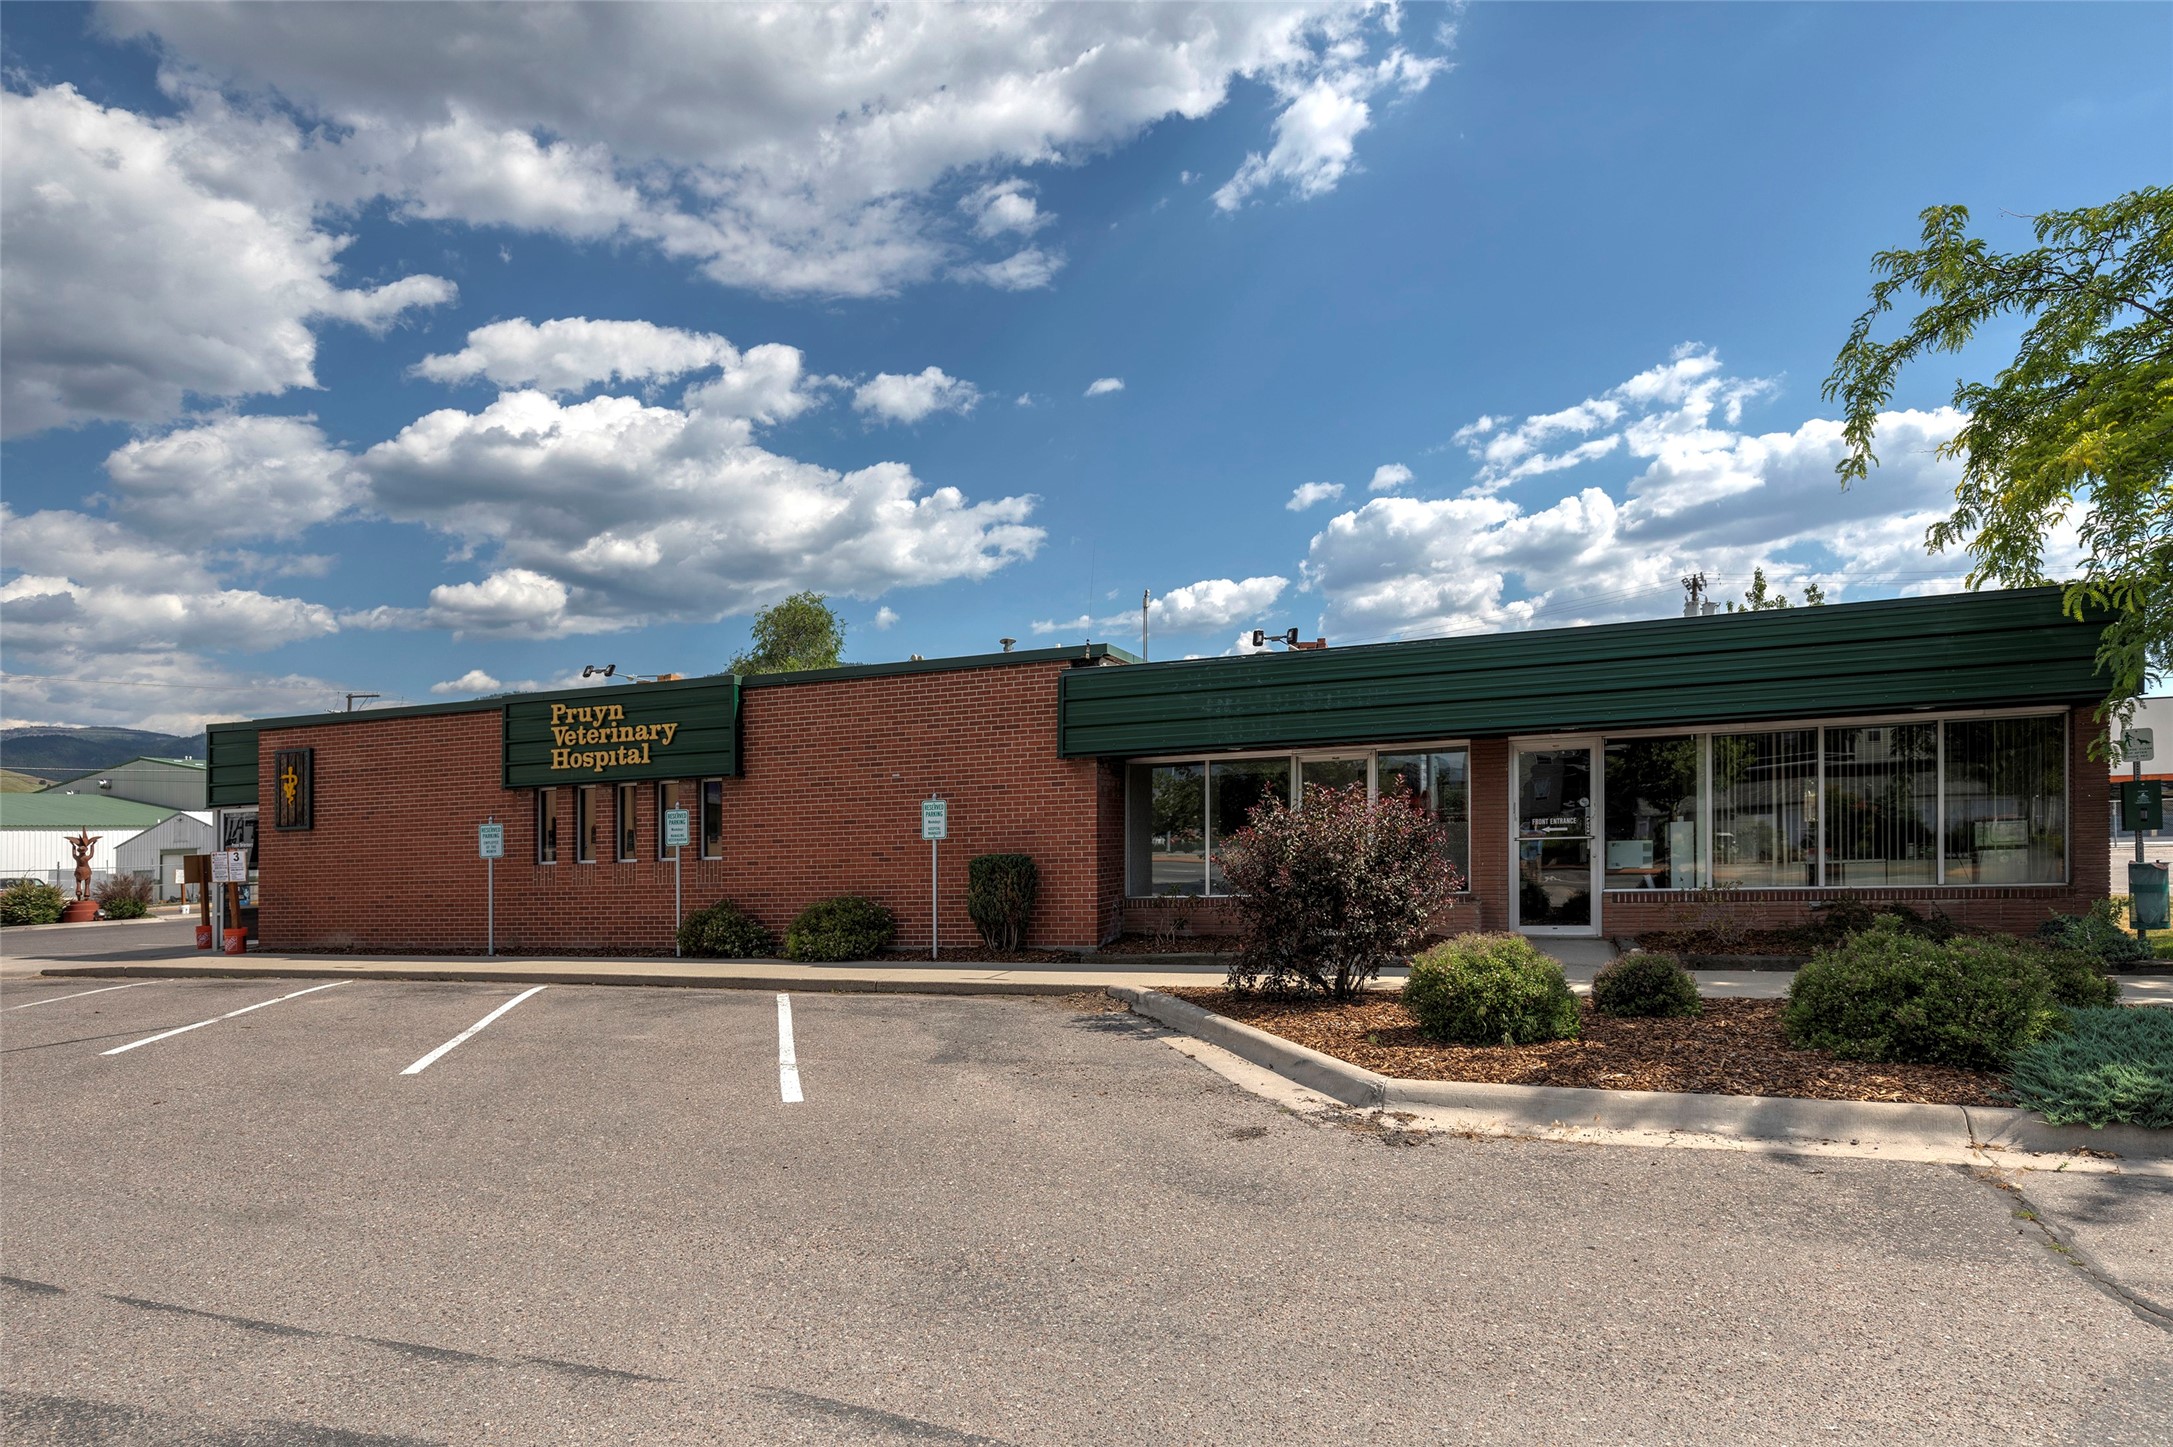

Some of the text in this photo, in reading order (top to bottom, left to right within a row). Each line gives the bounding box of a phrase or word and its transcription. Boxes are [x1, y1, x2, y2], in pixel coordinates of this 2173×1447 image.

[551, 703, 625, 728] Pruyn
[551, 721, 679, 747] Veterinary
[551, 743, 651, 772] Hospital
[1532, 817, 1577, 826] FRONT ENTRANCE
[233, 852, 240, 862] 3
